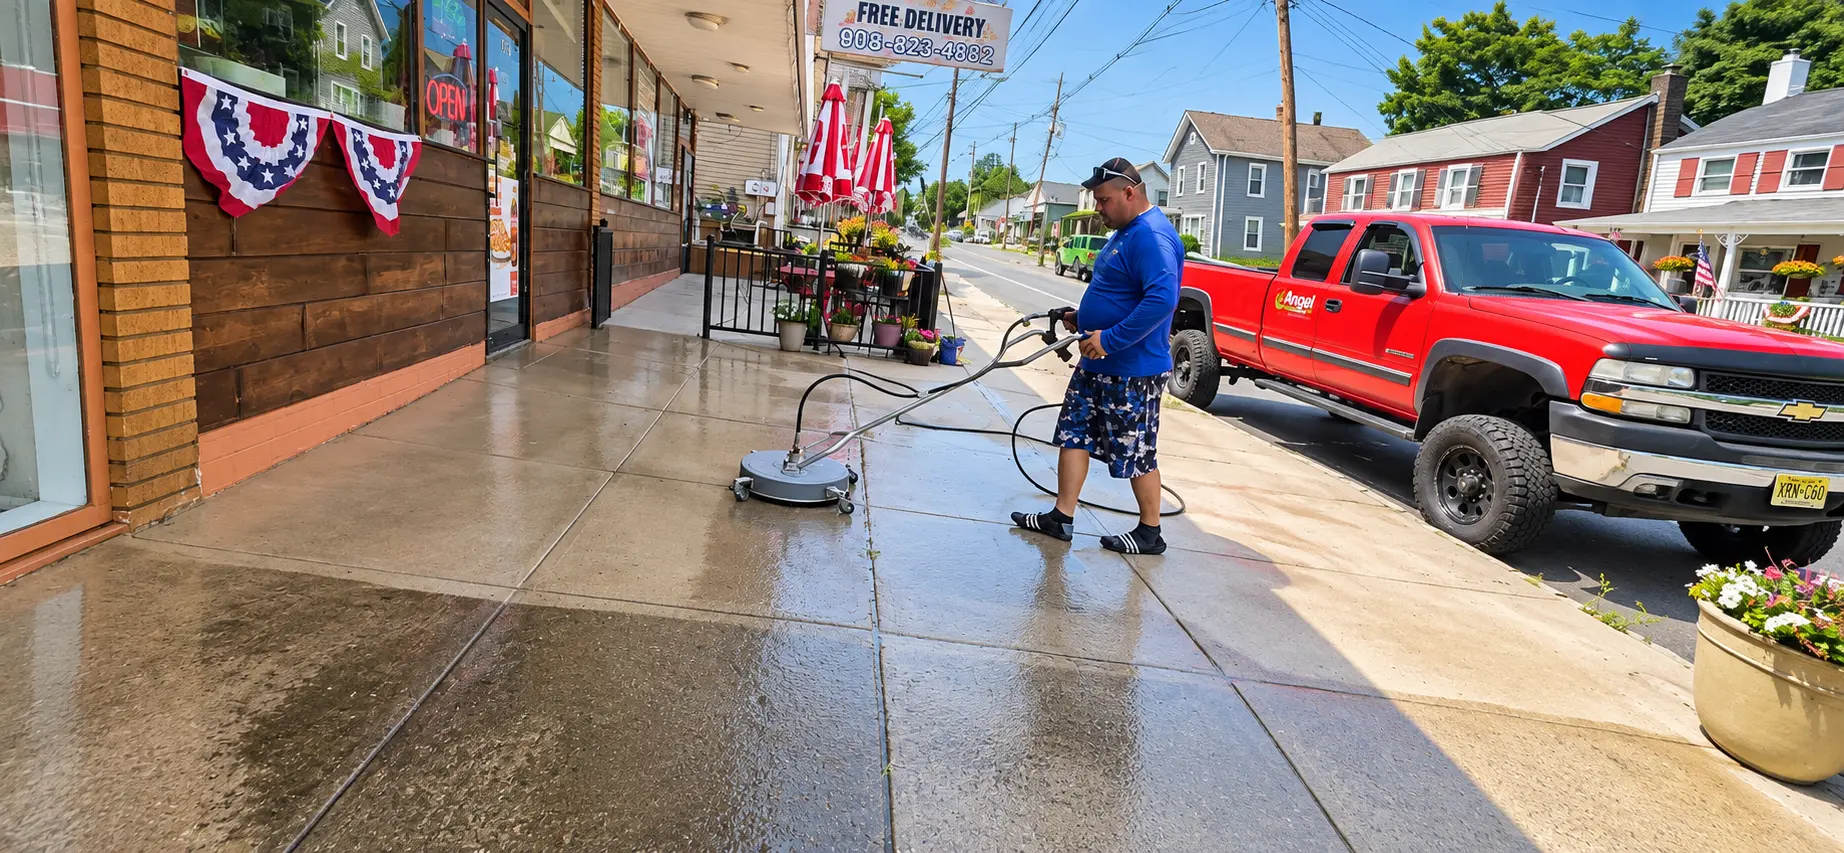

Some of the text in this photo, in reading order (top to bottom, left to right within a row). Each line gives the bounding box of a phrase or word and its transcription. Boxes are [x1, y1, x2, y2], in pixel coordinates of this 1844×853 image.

[857, 1, 987, 39] FREE DELIVERY
[839, 27, 995, 66] 908-823-4882
[426, 79, 466, 121] OPEN
[1283, 290, 1316, 310] Angel
